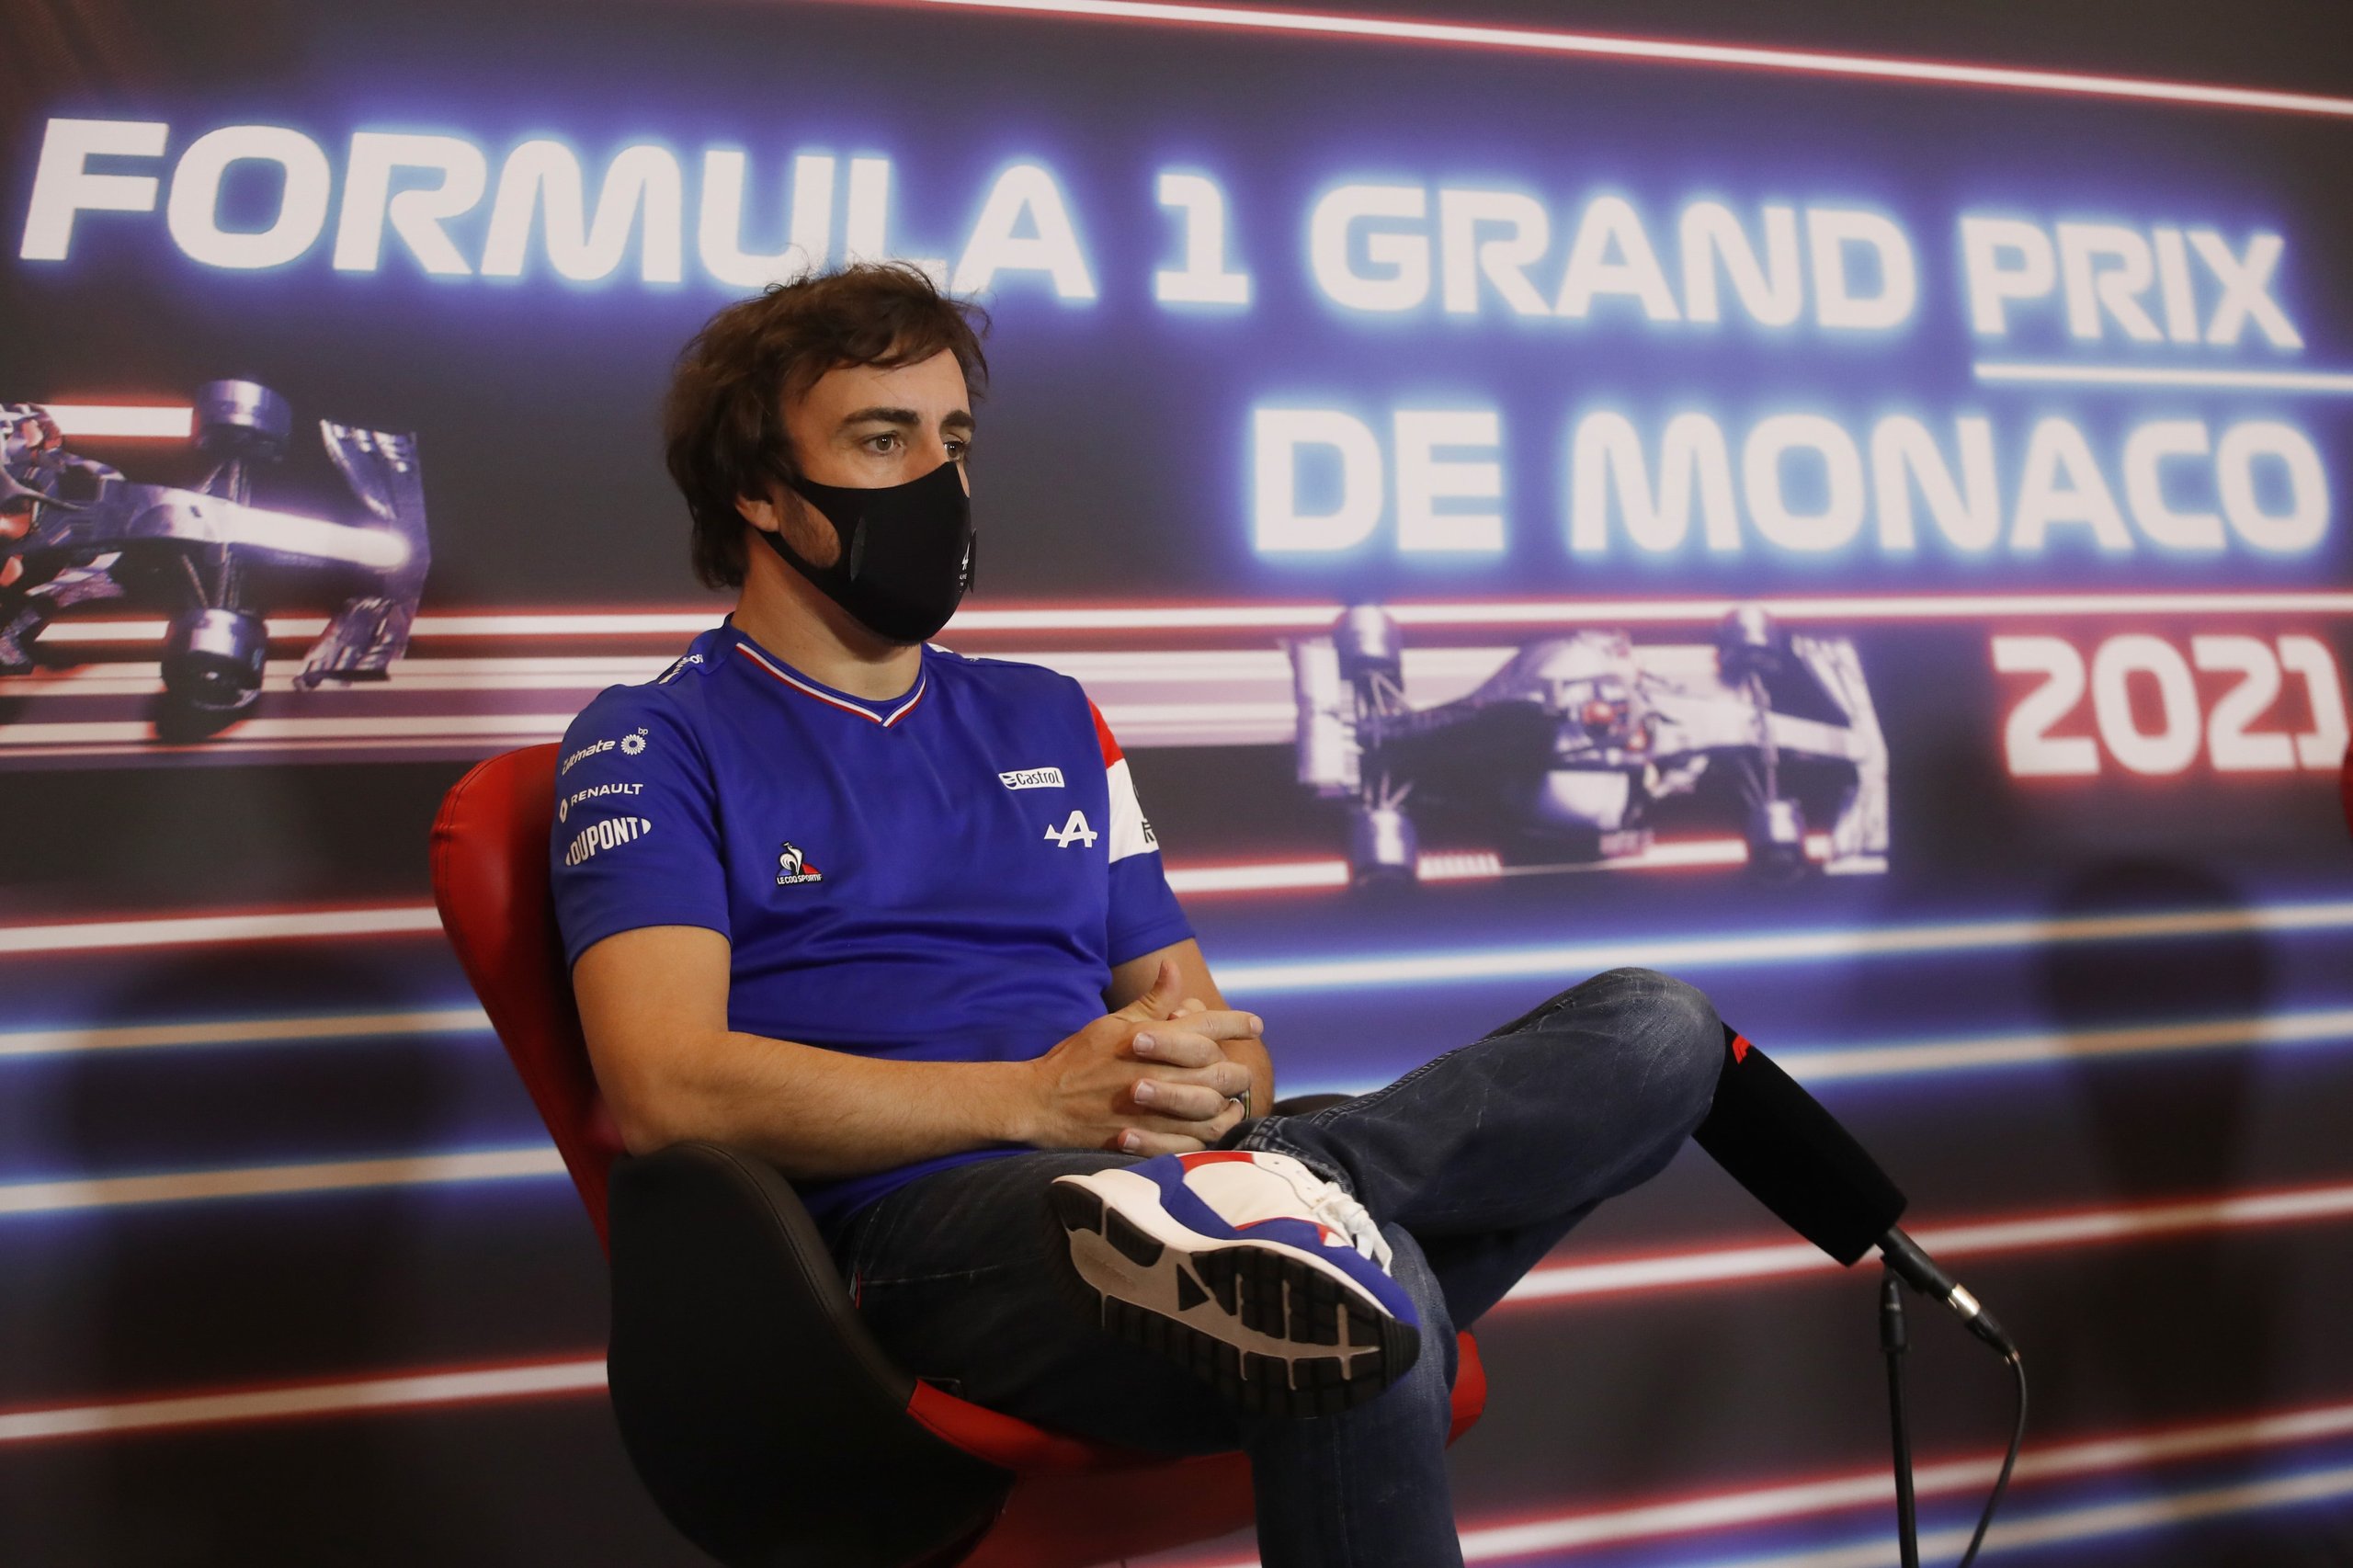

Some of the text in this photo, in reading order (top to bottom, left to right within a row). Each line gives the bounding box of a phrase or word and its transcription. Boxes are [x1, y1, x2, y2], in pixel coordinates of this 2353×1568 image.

[19, 118, 2306, 350] FORMULA 1 GRAND PRIX
[1252, 407, 2331, 553] DE MONACO
[1990, 634, 2350, 778] 2021
[638, 727, 649, 736] bp
[571, 783, 643, 807] RENAULT
[1016, 770, 1062, 785] Castrol
[570, 816, 638, 866] DUPONT
[777, 876, 785, 885] LE
